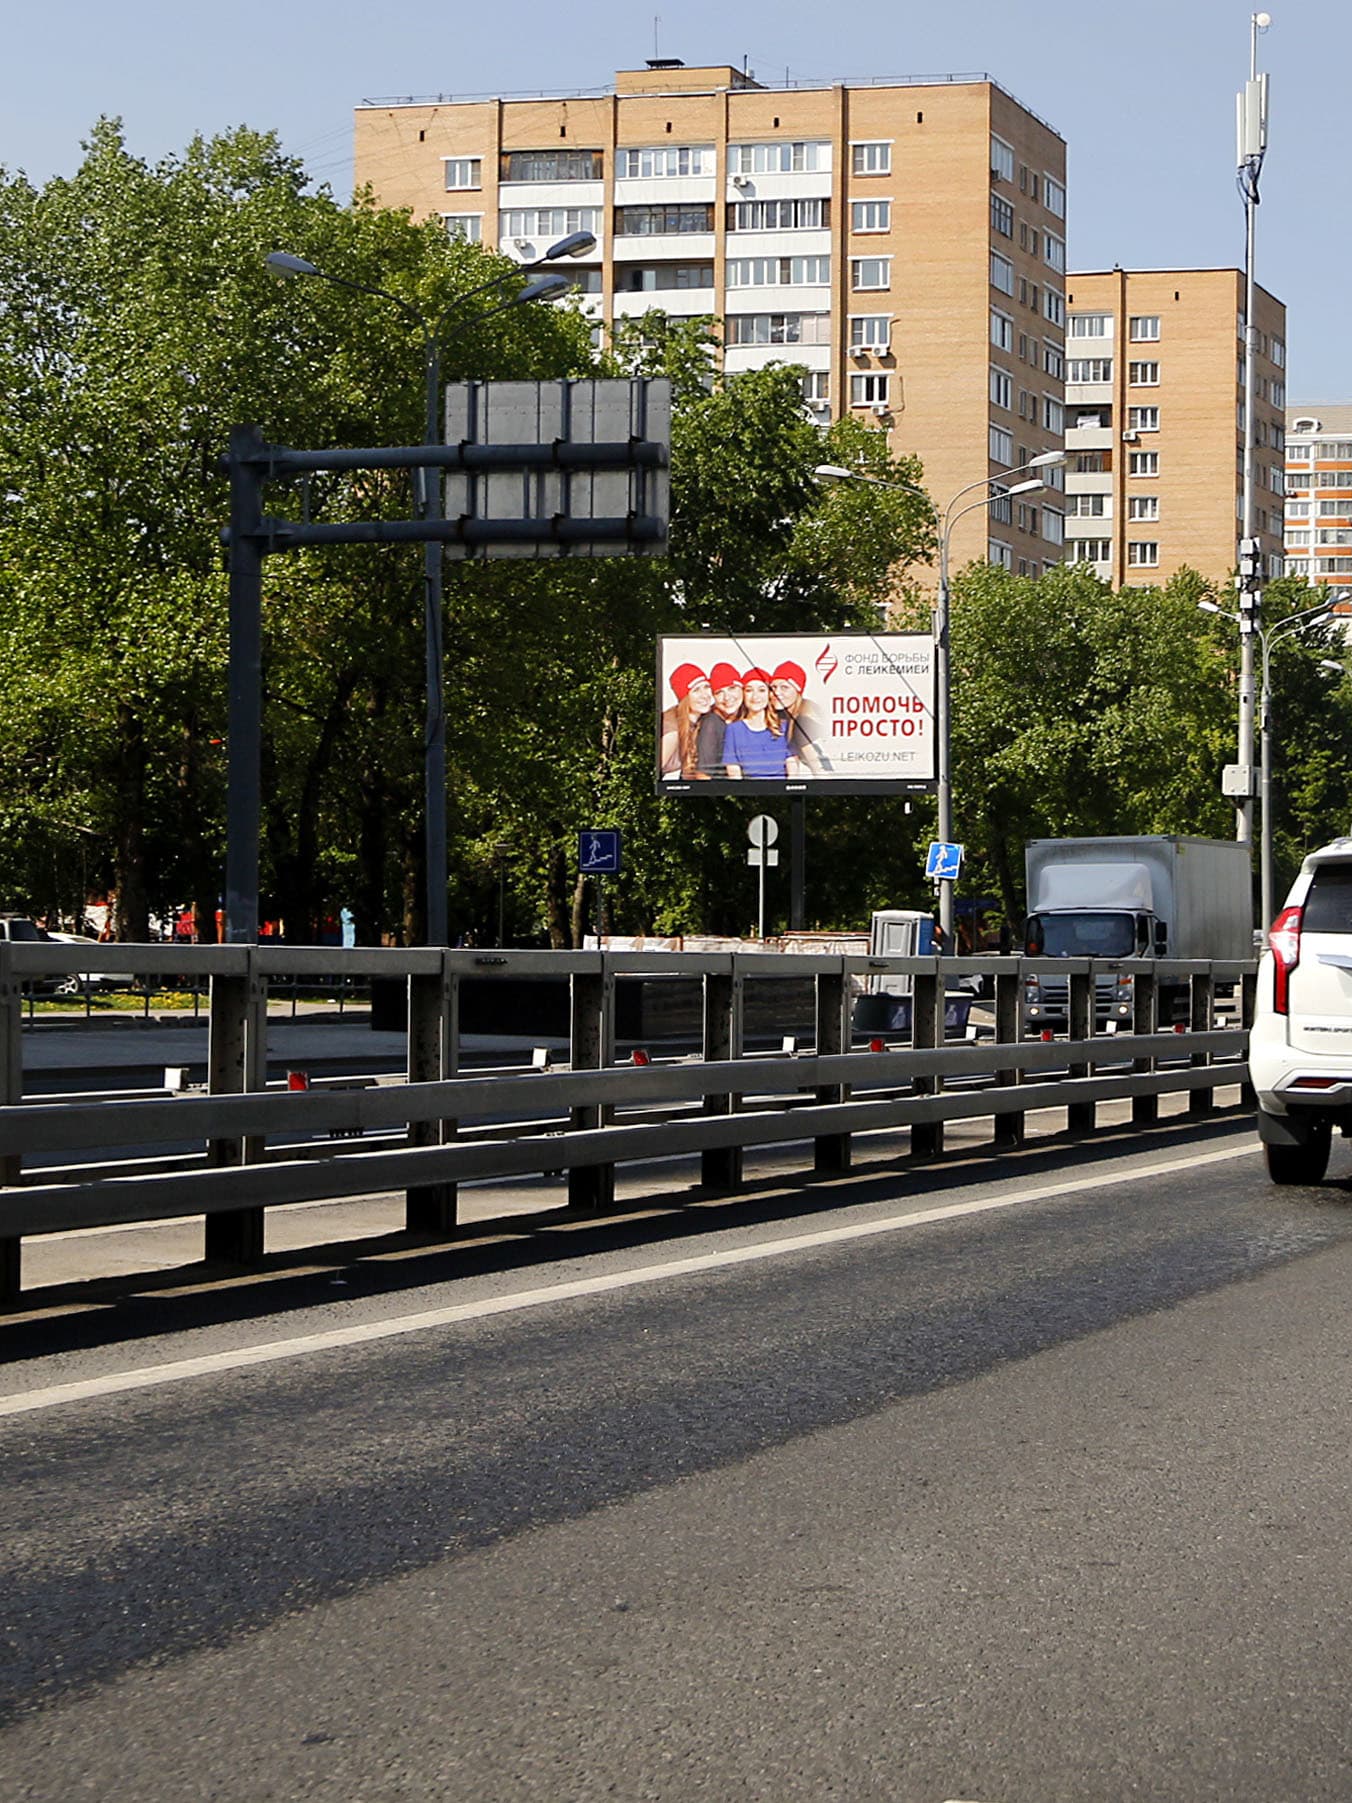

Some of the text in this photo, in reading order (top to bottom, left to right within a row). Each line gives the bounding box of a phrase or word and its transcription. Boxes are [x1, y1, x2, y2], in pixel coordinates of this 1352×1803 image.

[845, 653, 930, 663] ФОНД БОРЬБЫ
[845, 665, 929, 675] С ЛЕЙКЕМИЕЙ
[832, 696, 924, 714] ПОМОЧЬ
[832, 719, 923, 737] ПРОСТО!
